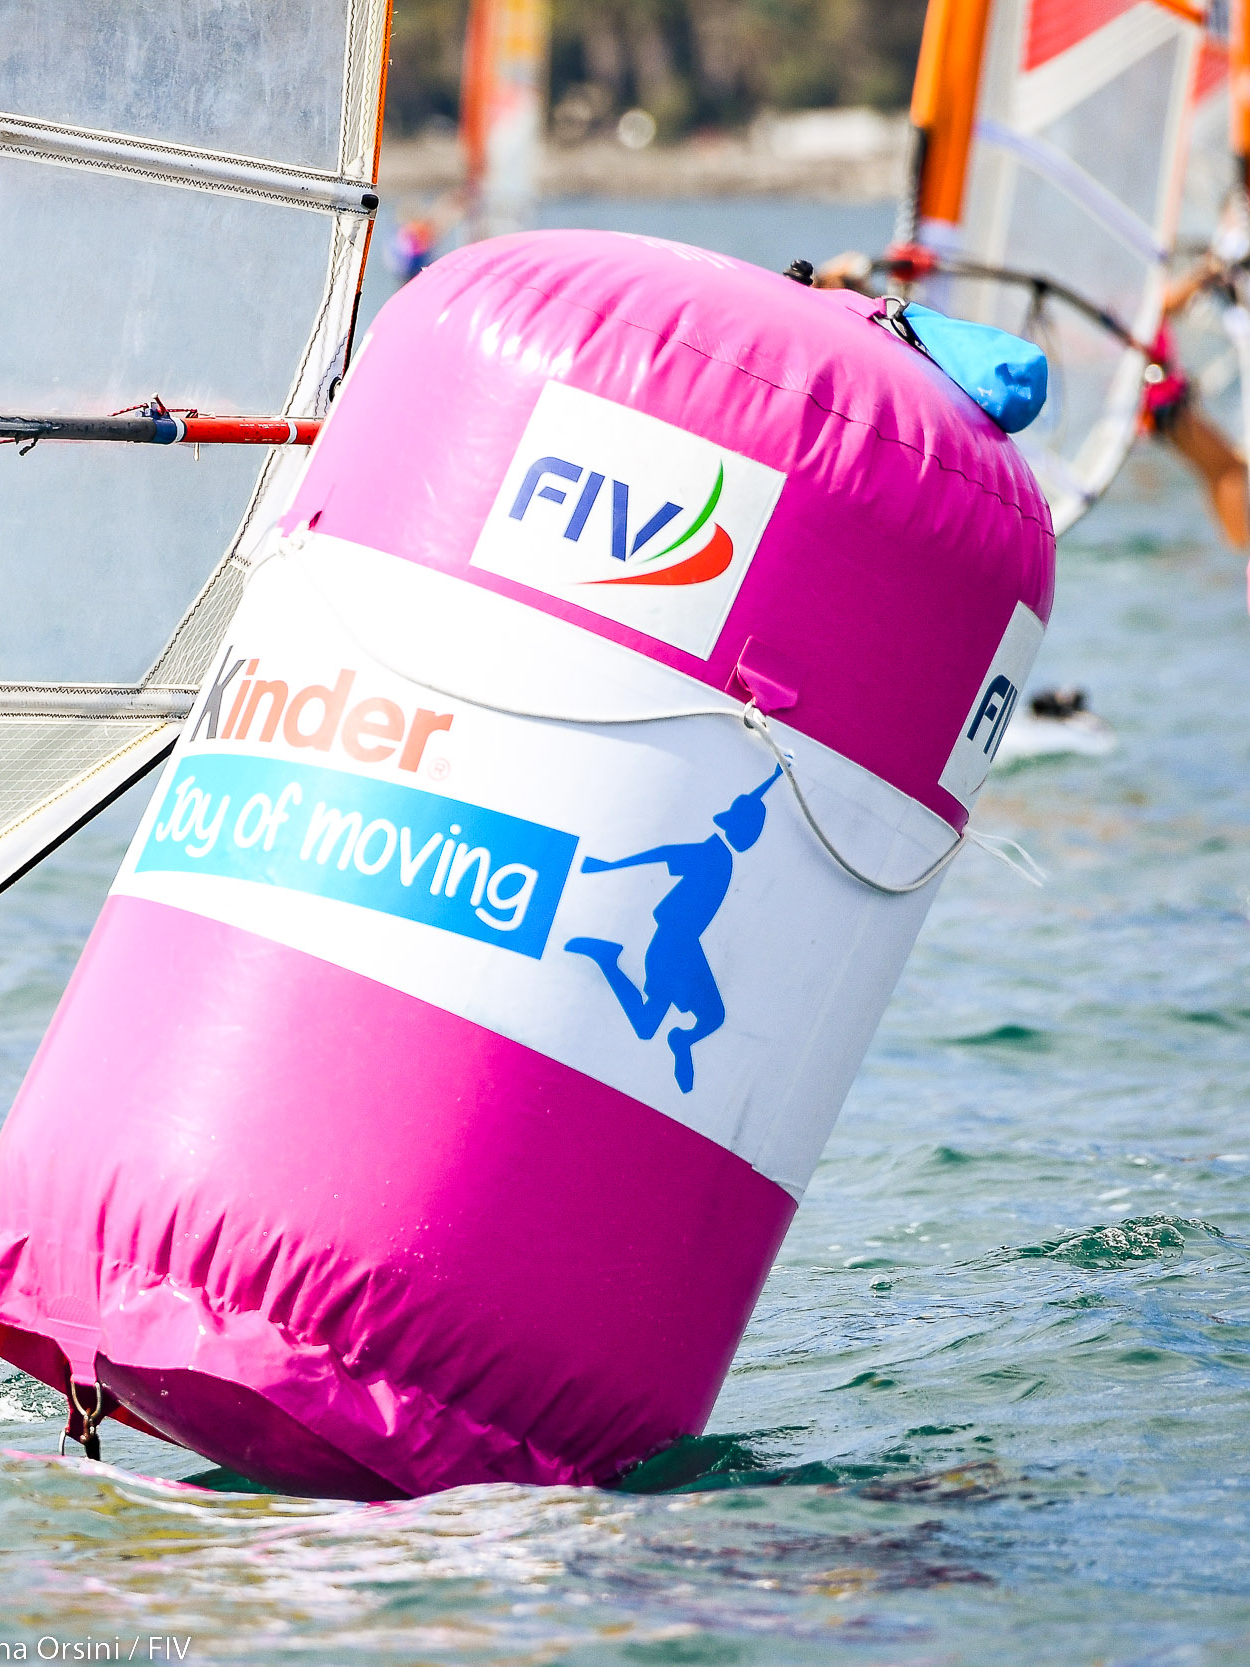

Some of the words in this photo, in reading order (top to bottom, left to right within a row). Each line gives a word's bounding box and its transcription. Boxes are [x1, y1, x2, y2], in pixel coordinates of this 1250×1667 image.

[509, 456, 684, 561] FIV
[190, 644, 454, 773] Kinder
[156, 775, 230, 858] Joy
[233, 782, 303, 852] of
[299, 801, 539, 932] moving
